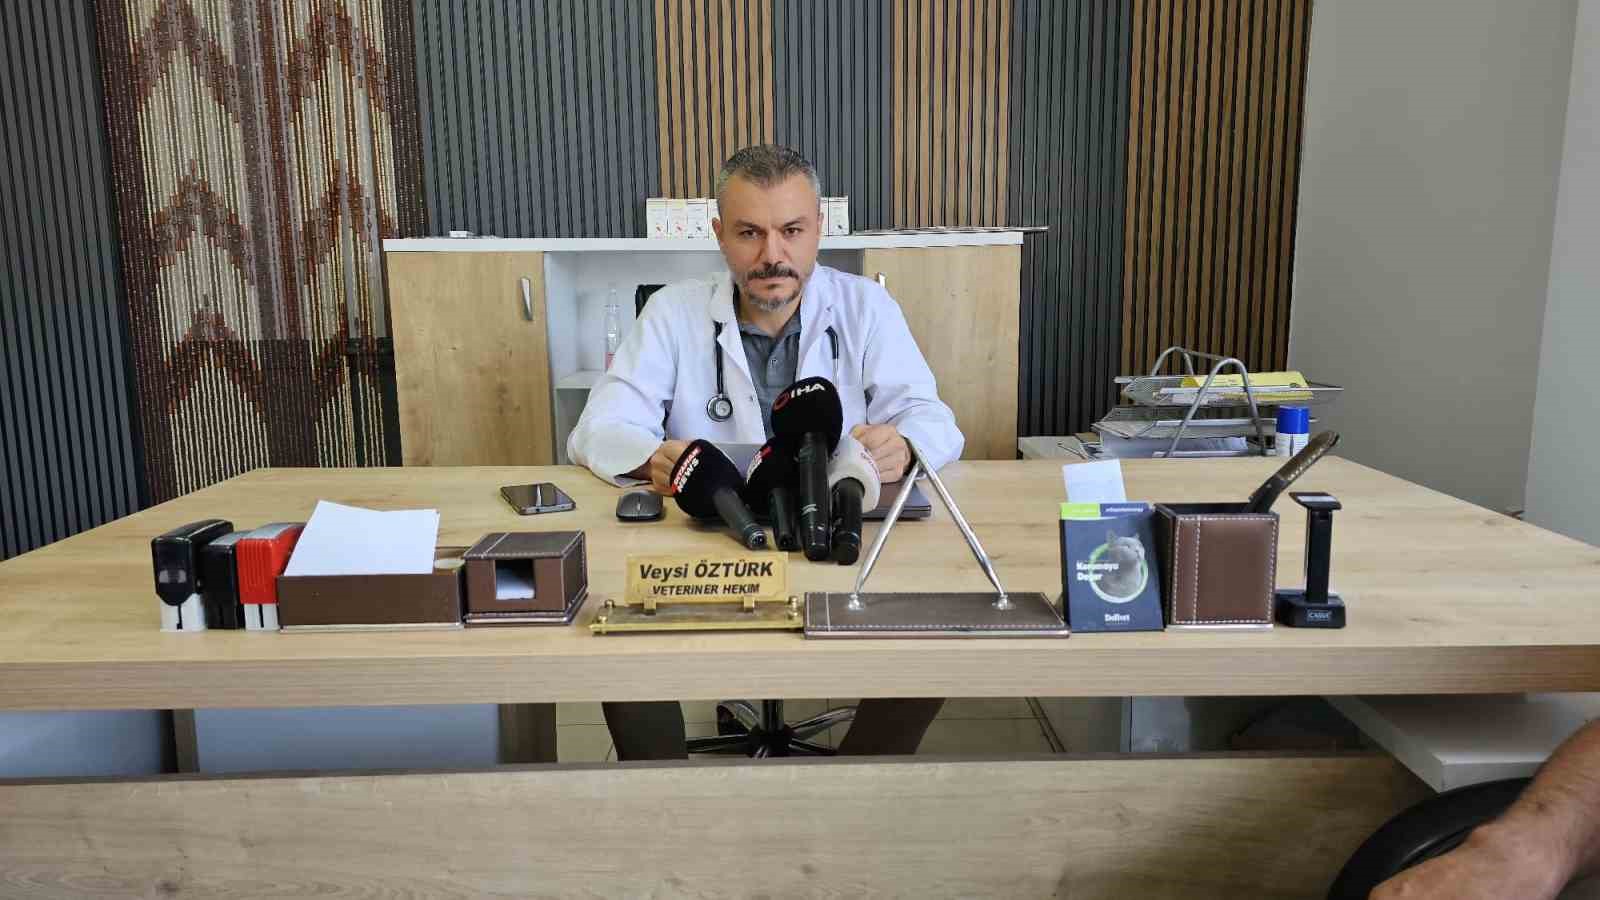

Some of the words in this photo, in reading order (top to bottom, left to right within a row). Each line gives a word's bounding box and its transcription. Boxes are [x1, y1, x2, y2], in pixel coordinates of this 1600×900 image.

[677, 457, 699, 493] NEWS
[640, 563, 688, 582] Veysi
[694, 559, 773, 578] ÖZTÜRK
